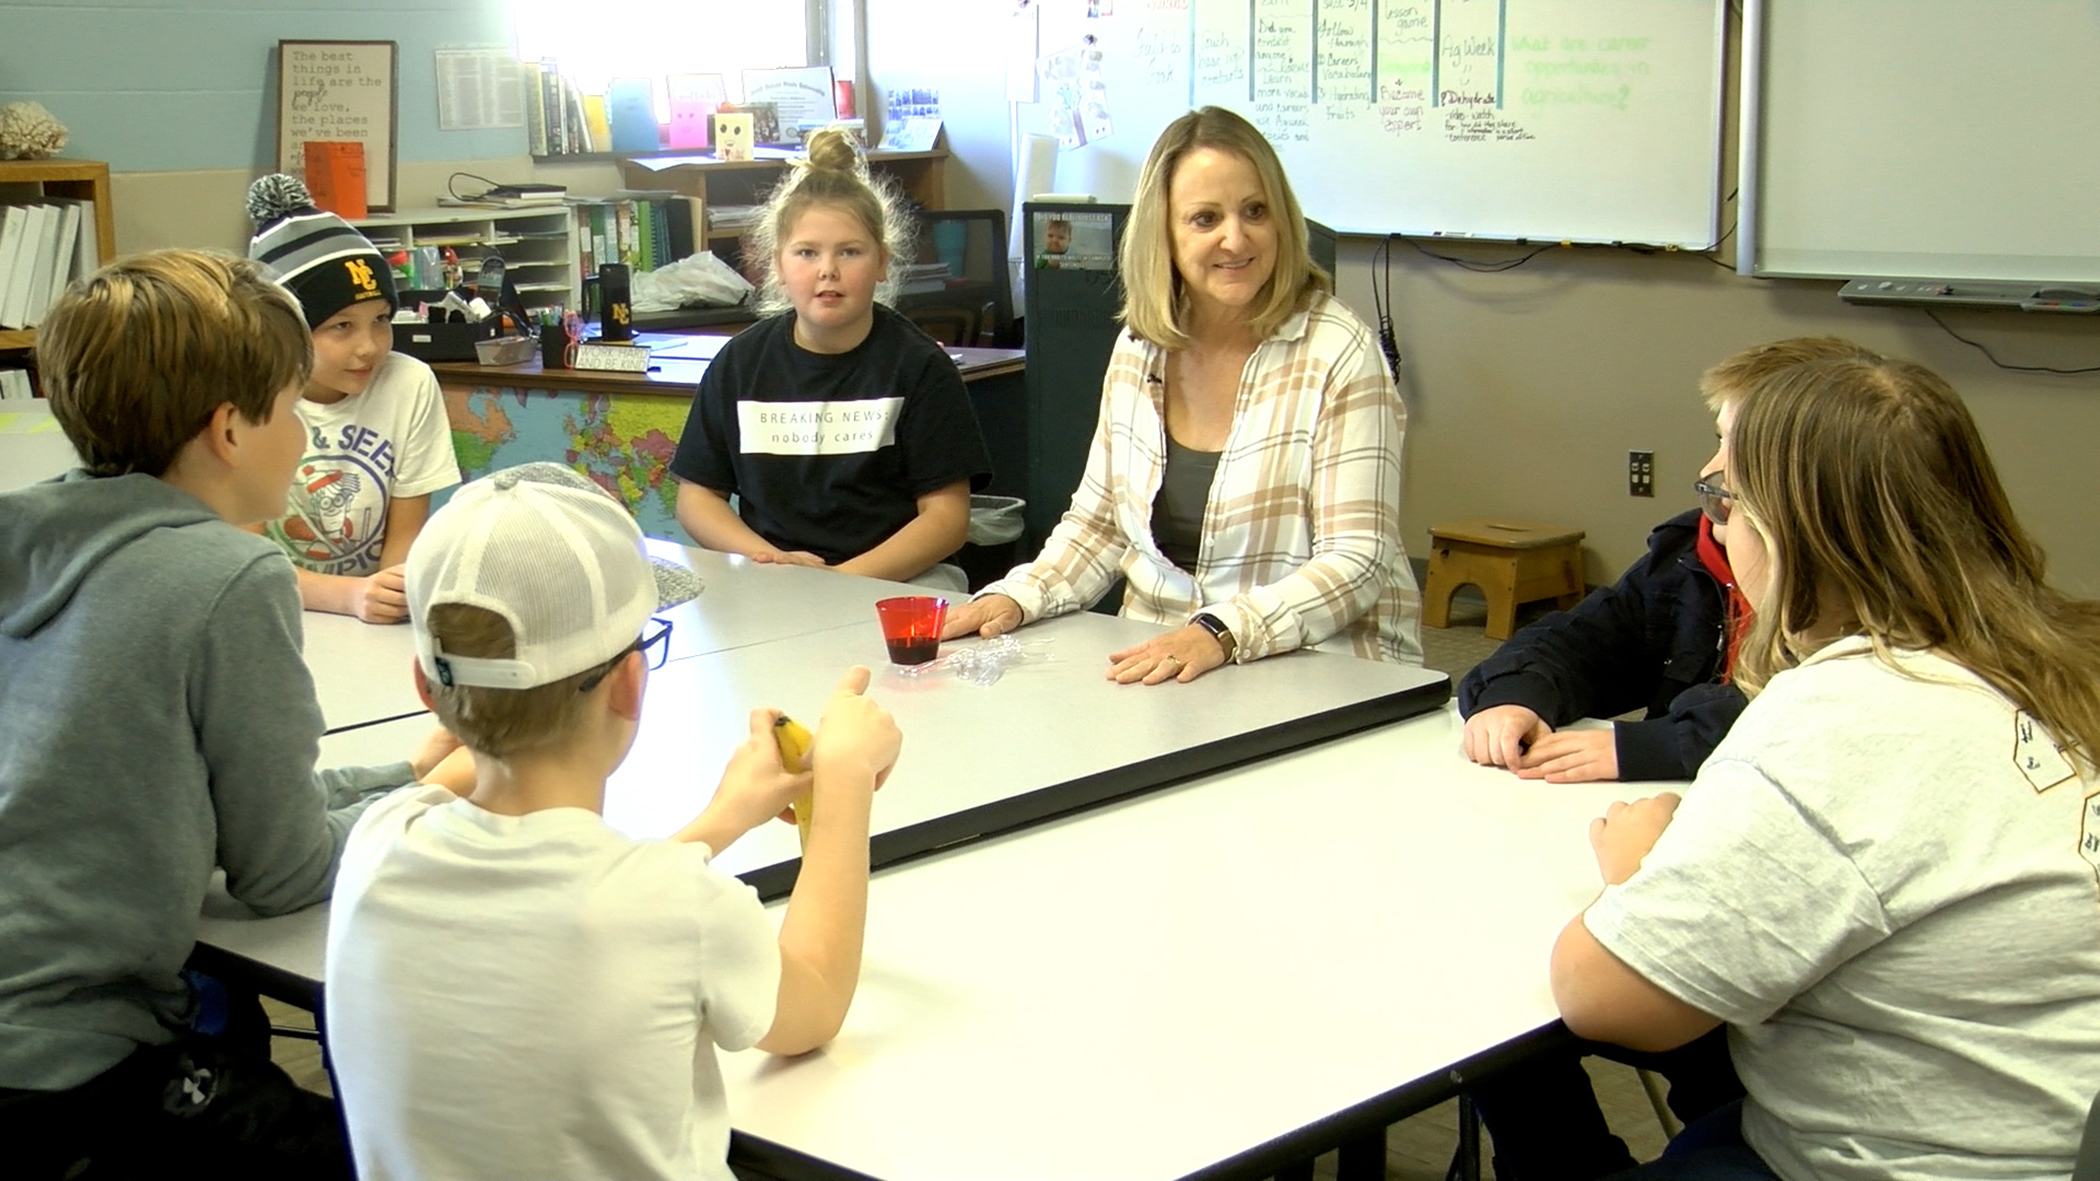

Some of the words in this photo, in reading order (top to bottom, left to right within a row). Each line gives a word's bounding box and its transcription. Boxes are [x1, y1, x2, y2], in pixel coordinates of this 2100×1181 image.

[1258, 18, 1277, 33] Did
[1395, 17, 1428, 36] game
[292, 51, 316, 61] The
[321, 51, 353, 61] best
[1442, 34, 1461, 68] Ag
[1463, 36, 1496, 57] Week
[292, 64, 340, 76] things
[346, 64, 362, 74] in
[293, 77, 325, 87] life
[329, 79, 353, 87] are
[359, 77, 382, 87] the
[1262, 73, 1292, 84] Learn
[292, 84, 328, 107] people
[1257, 88, 1282, 98] more
[292, 104, 307, 112] we
[315, 102, 350, 113] love,
[292, 115, 315, 125] the
[320, 115, 368, 127] places
[291, 127, 331, 138] we've
[336, 127, 368, 138] been
[344, 258, 377, 291] NC
[612, 303, 629, 325] NC
[580, 346, 613, 357] WORK
[617, 348, 648, 359] HARD
[577, 358, 600, 368] AND
[605, 359, 619, 369] BE
[621, 360, 646, 370] KIND
[760, 412, 833, 424] BREAKING
[842, 410, 889, 422] NEWS:
[771, 432, 825, 445] nobody
[834, 431, 873, 442] cares
[311, 426, 331, 449] &
[338, 424, 396, 477] SEE
